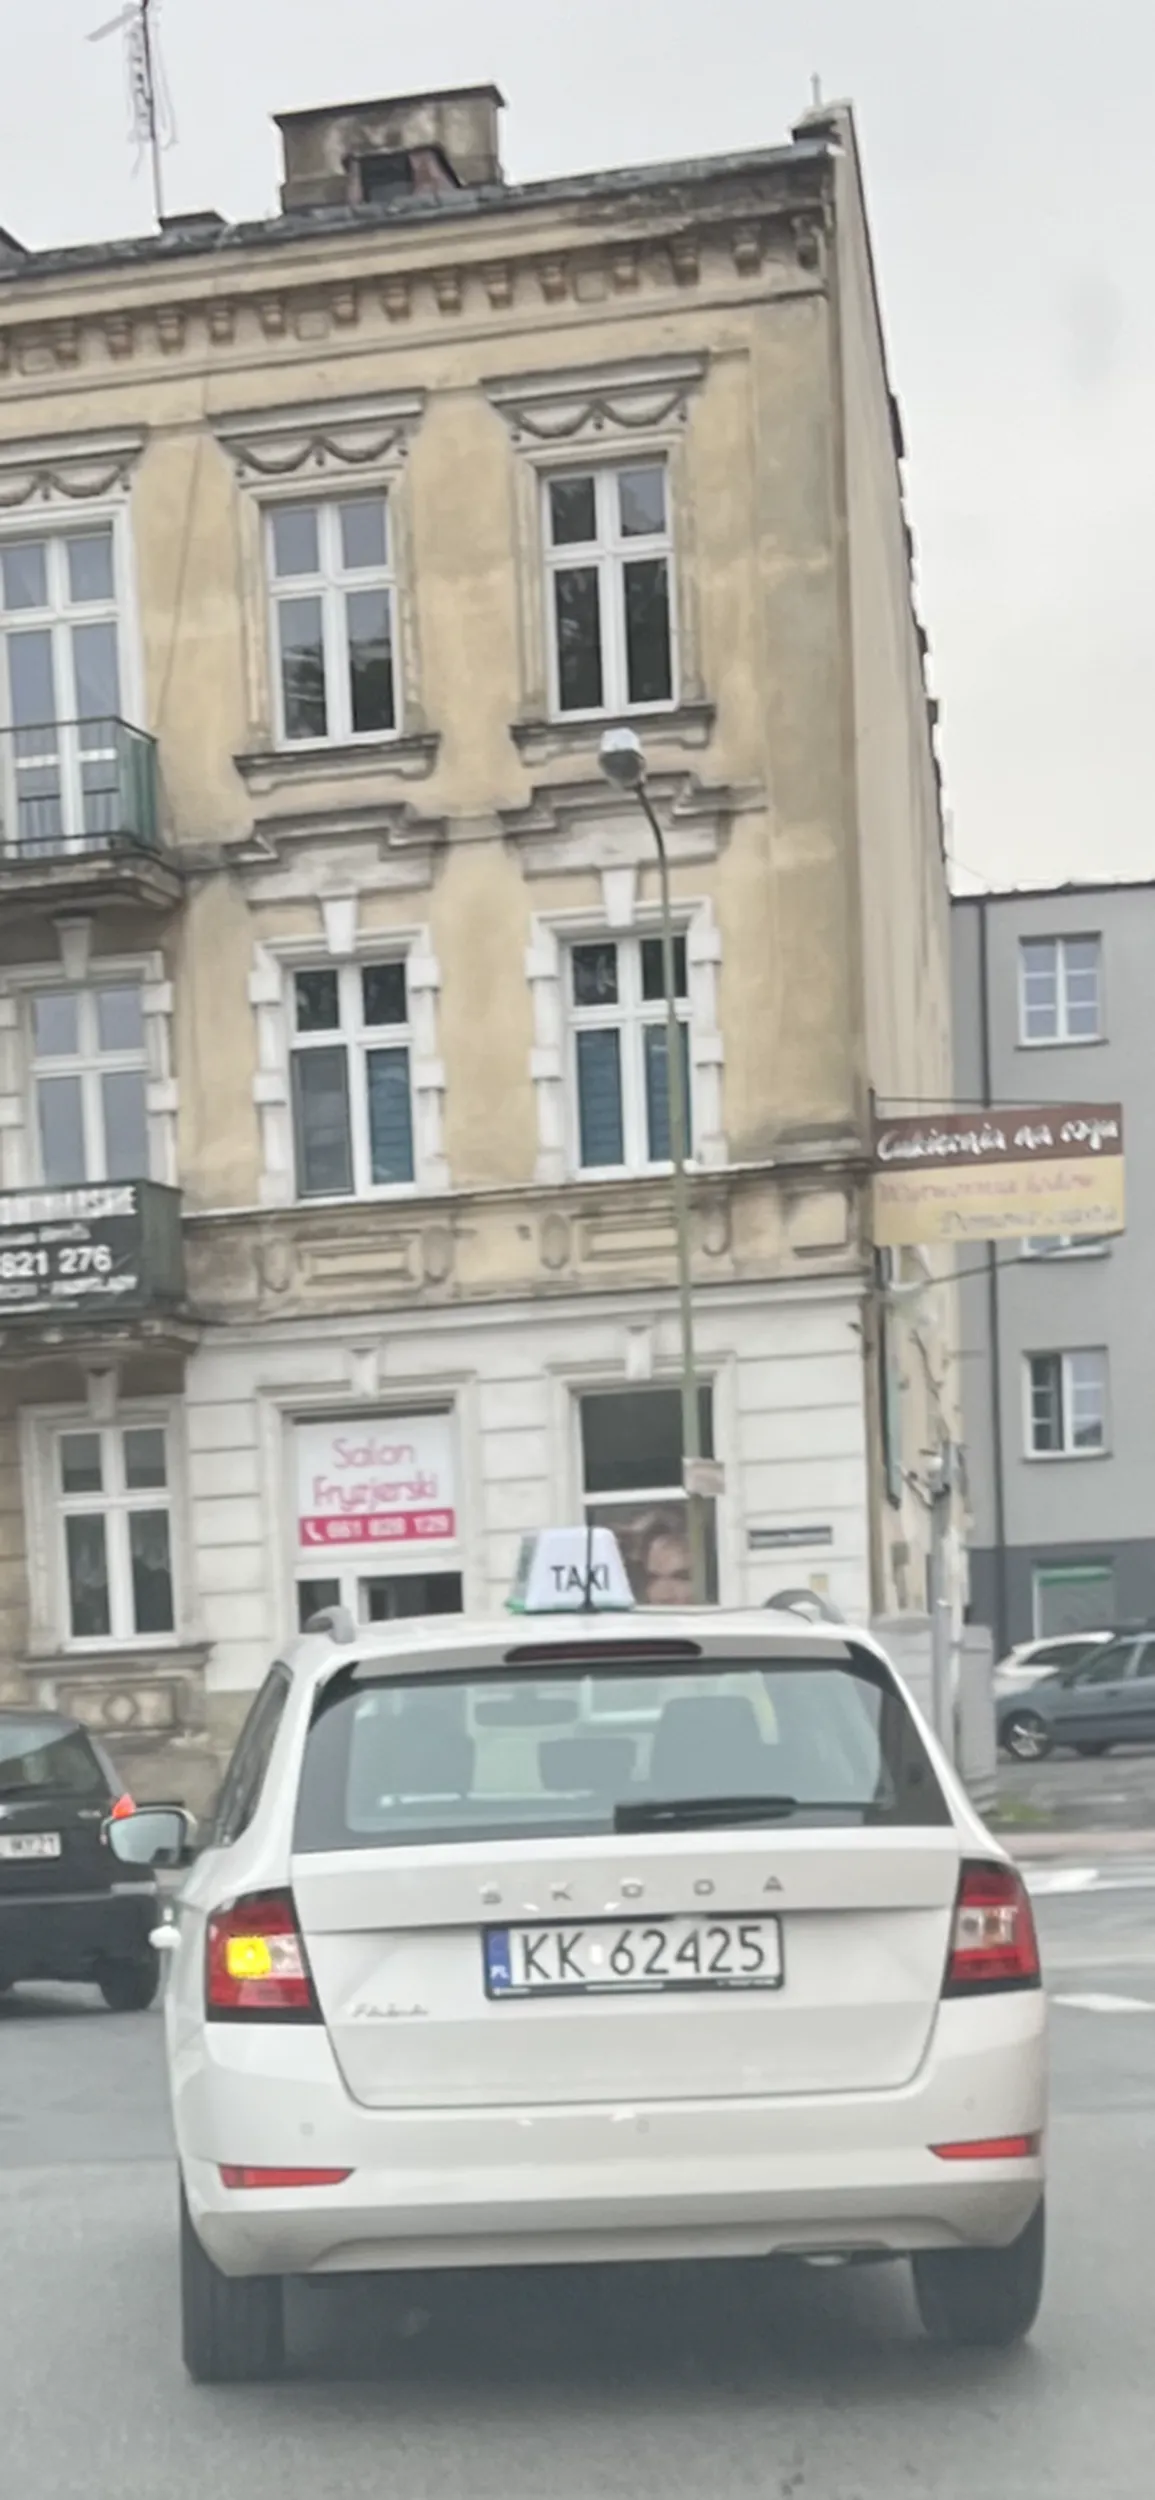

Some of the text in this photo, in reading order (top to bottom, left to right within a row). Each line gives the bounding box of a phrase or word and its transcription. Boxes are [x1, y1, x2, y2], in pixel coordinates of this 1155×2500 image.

[1013, 1124, 1054, 1151] na
[58, 1245, 112, 1274] 276
[332, 1437, 414, 1469] Salon
[312, 1470, 438, 1513] Fryzjerski
[549, 1562, 611, 1592] TAXI
[521, 1925, 766, 1981] KK 62425
